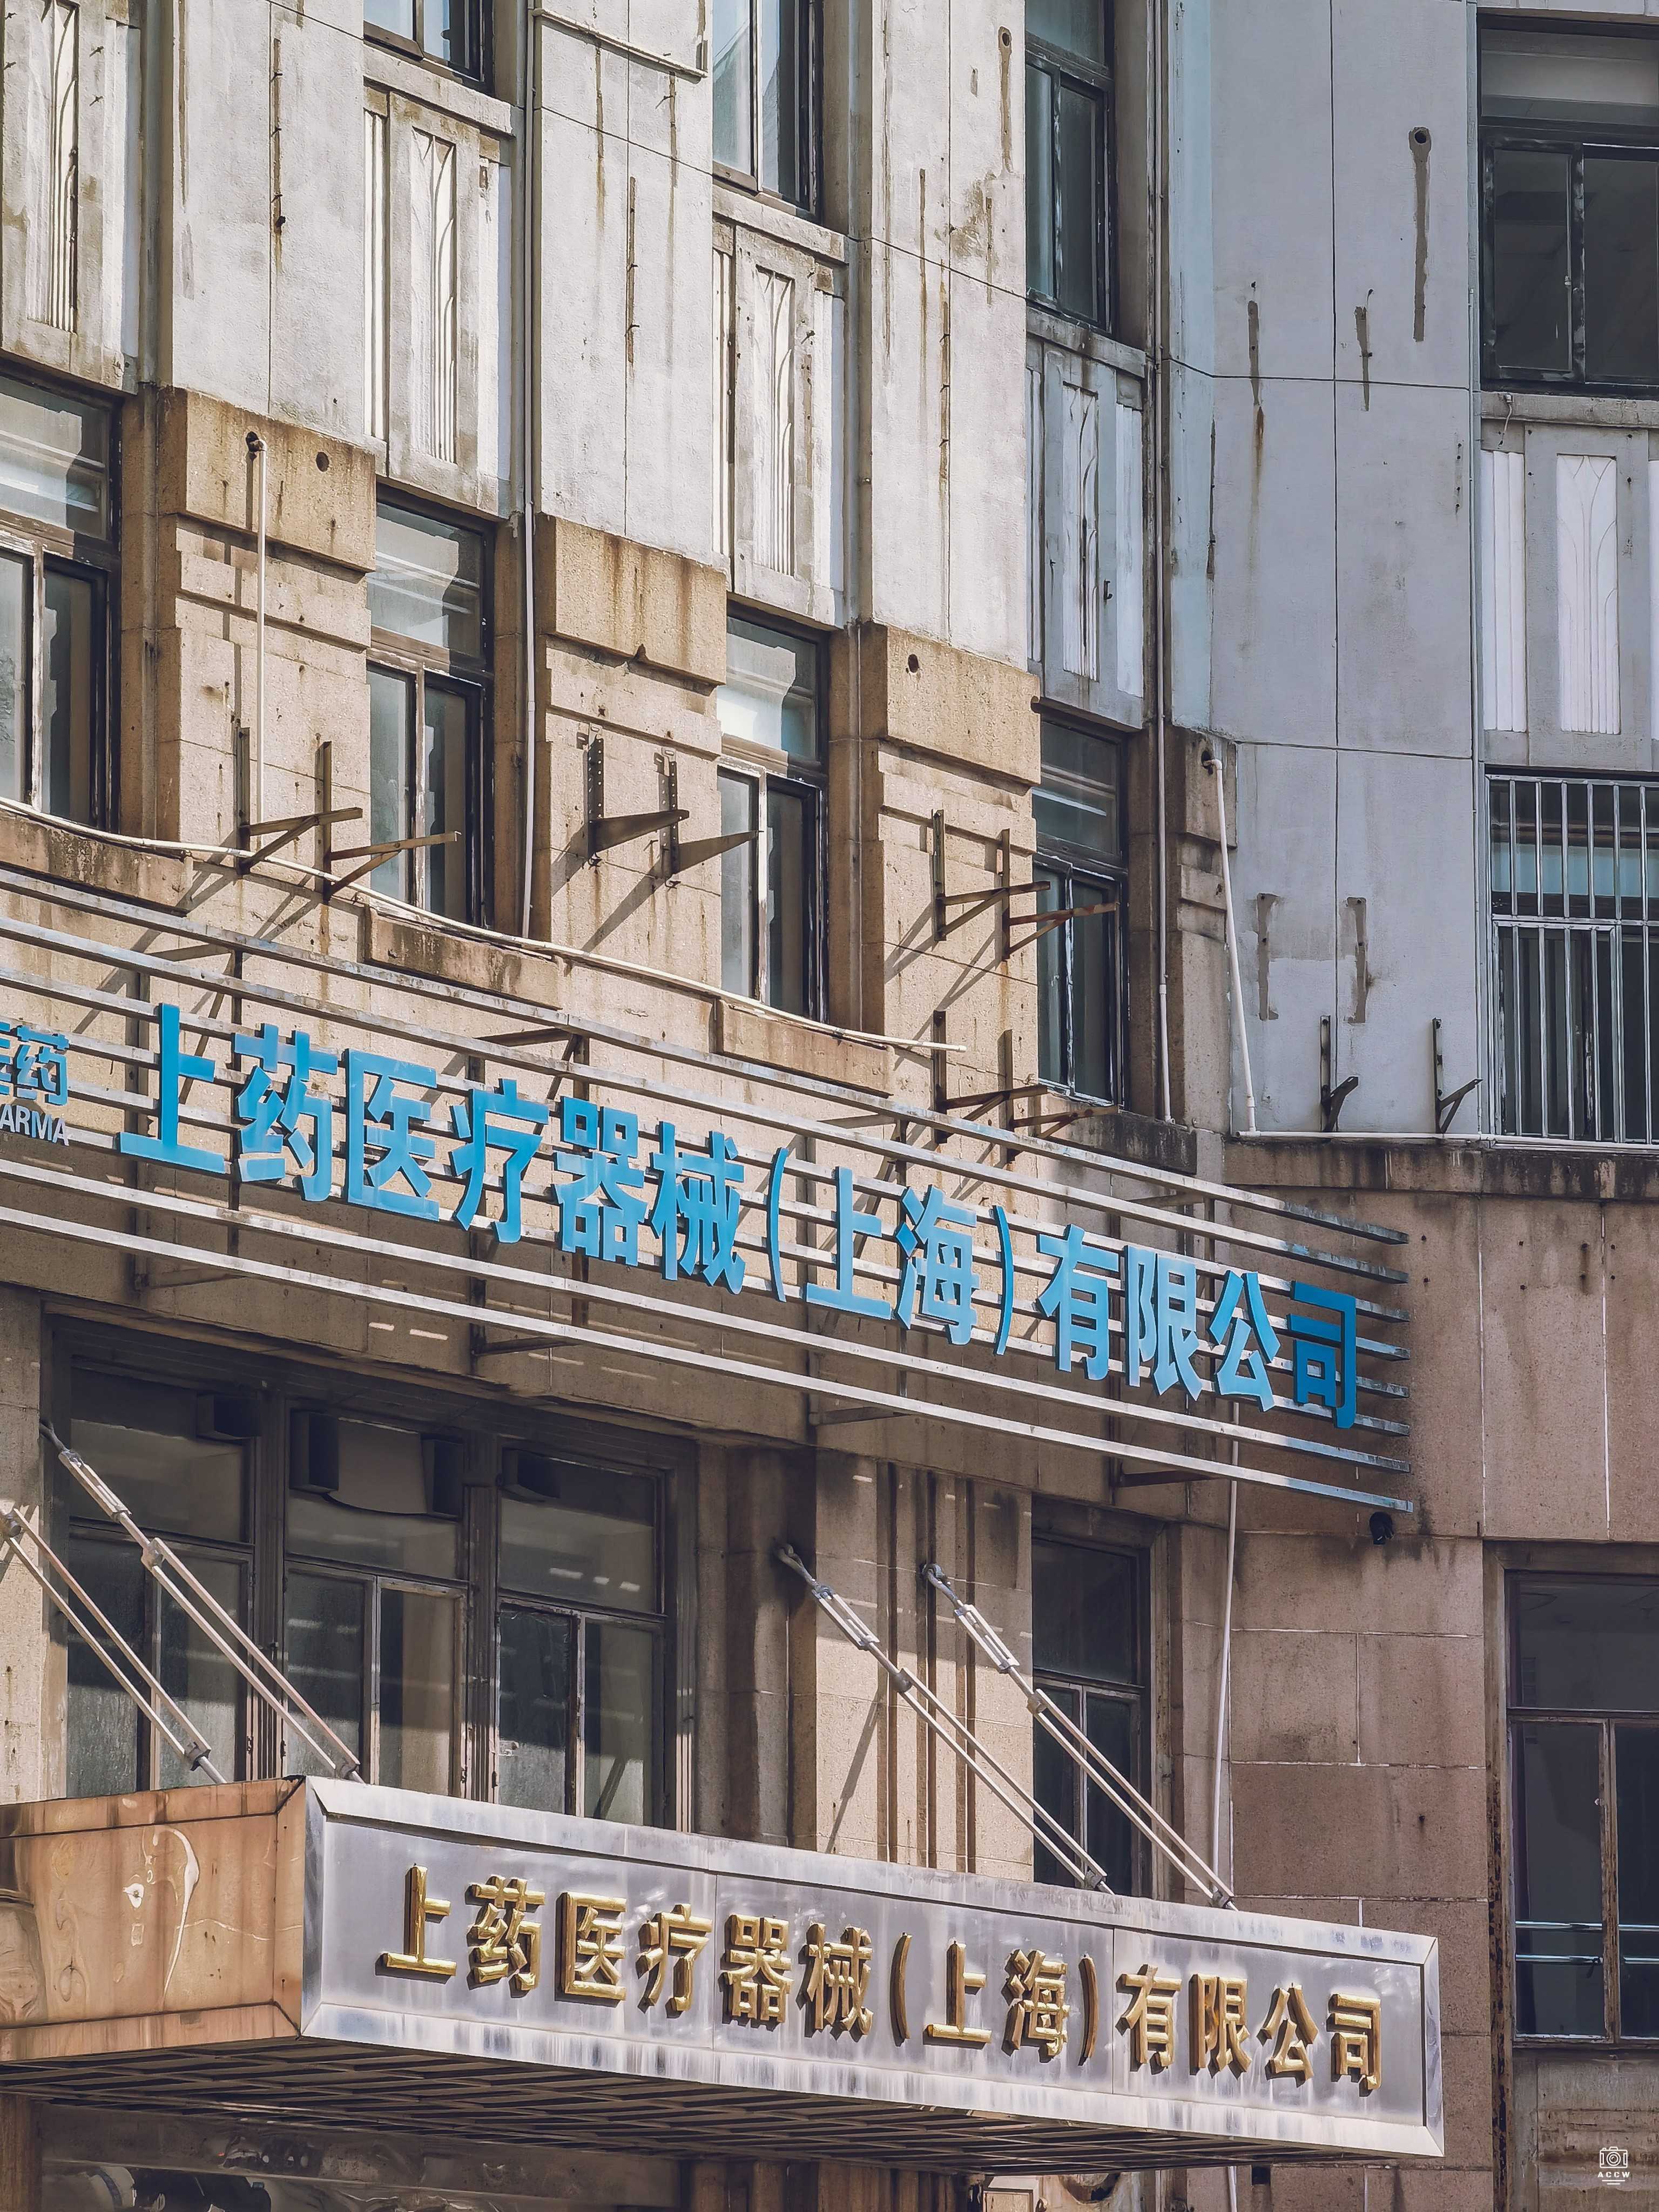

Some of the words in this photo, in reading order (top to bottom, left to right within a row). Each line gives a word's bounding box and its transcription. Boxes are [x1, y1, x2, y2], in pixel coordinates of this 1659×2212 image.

[0, 1022, 69, 1106] 药
[117, 1003, 1358, 1429] 上药医疗器械(上海)有限公司
[379, 1863, 1382, 2092] 上药医疗器械(上海)有限公司
